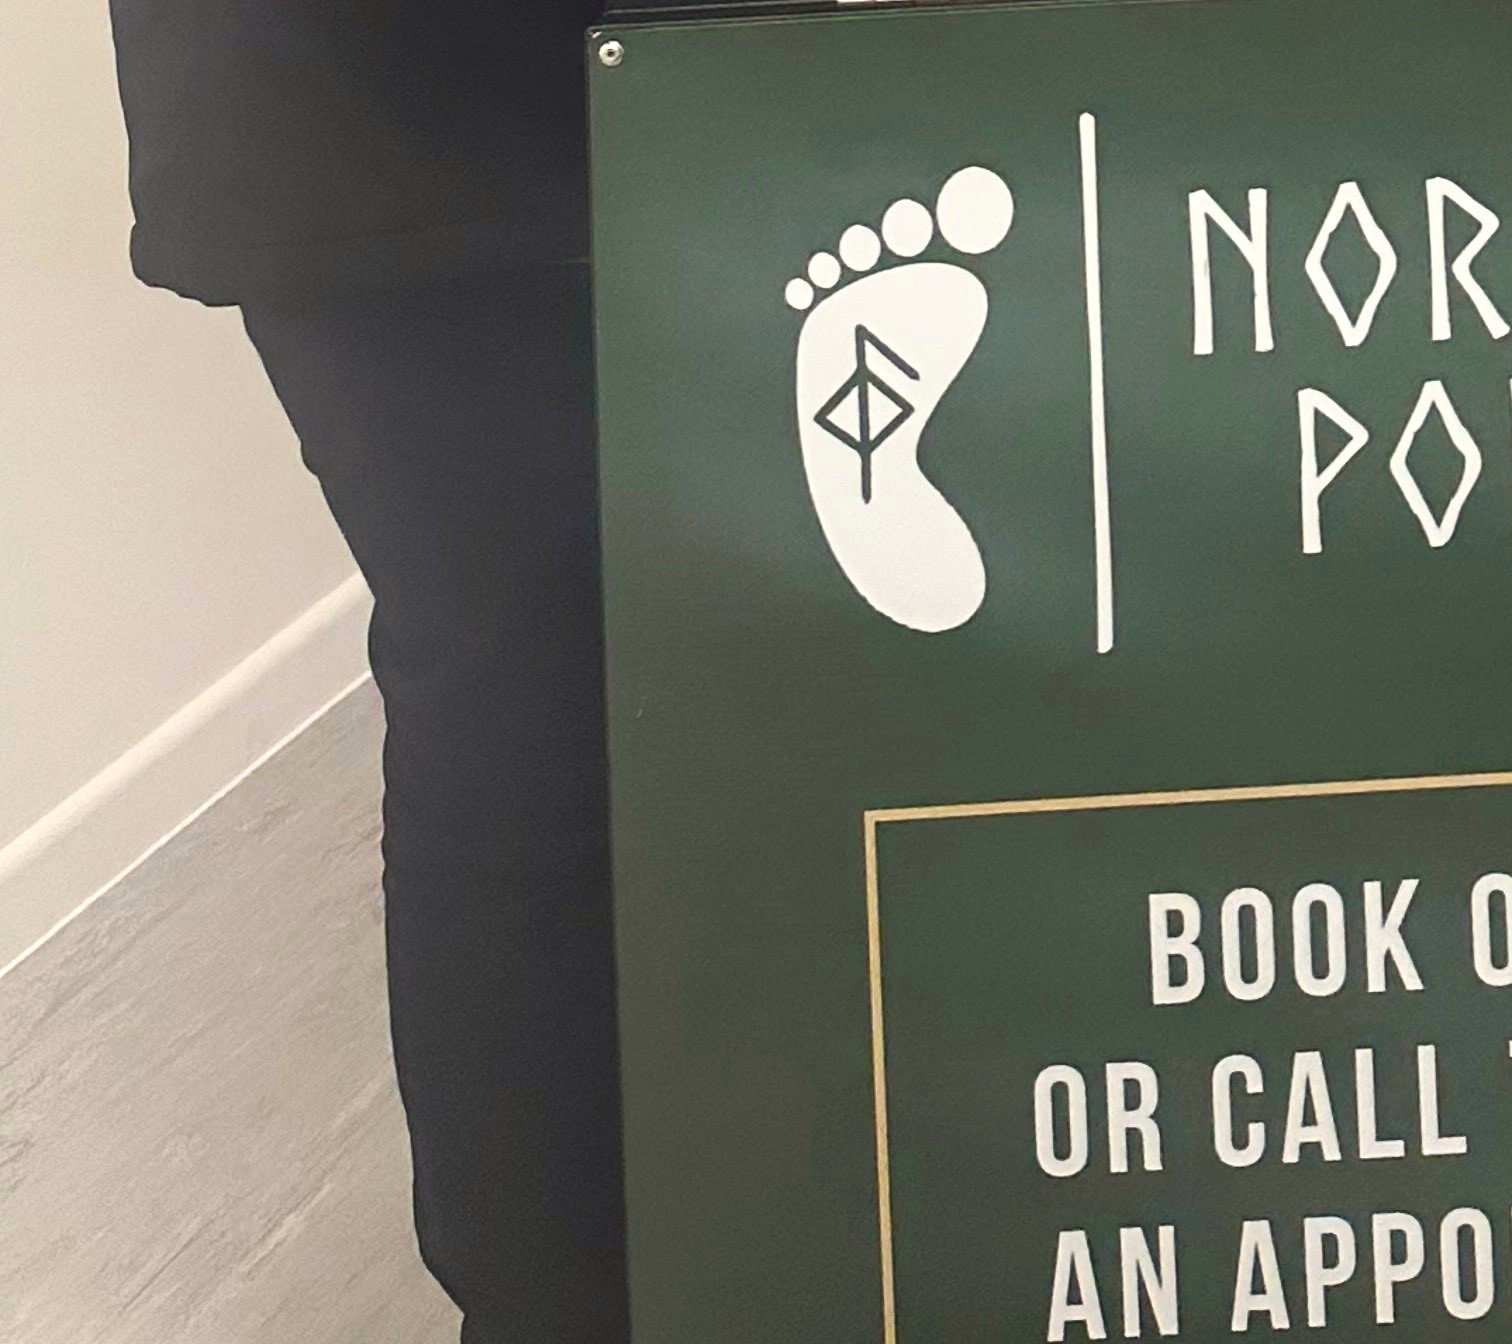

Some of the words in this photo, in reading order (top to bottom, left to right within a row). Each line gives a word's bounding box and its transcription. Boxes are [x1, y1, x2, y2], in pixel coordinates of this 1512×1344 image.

[1148, 878, 1425, 1006] BOOK
[1033, 1061, 1163, 1178] OR
[1211, 1044, 1468, 1168] CALL
[1047, 1225, 1179, 1343] AN
